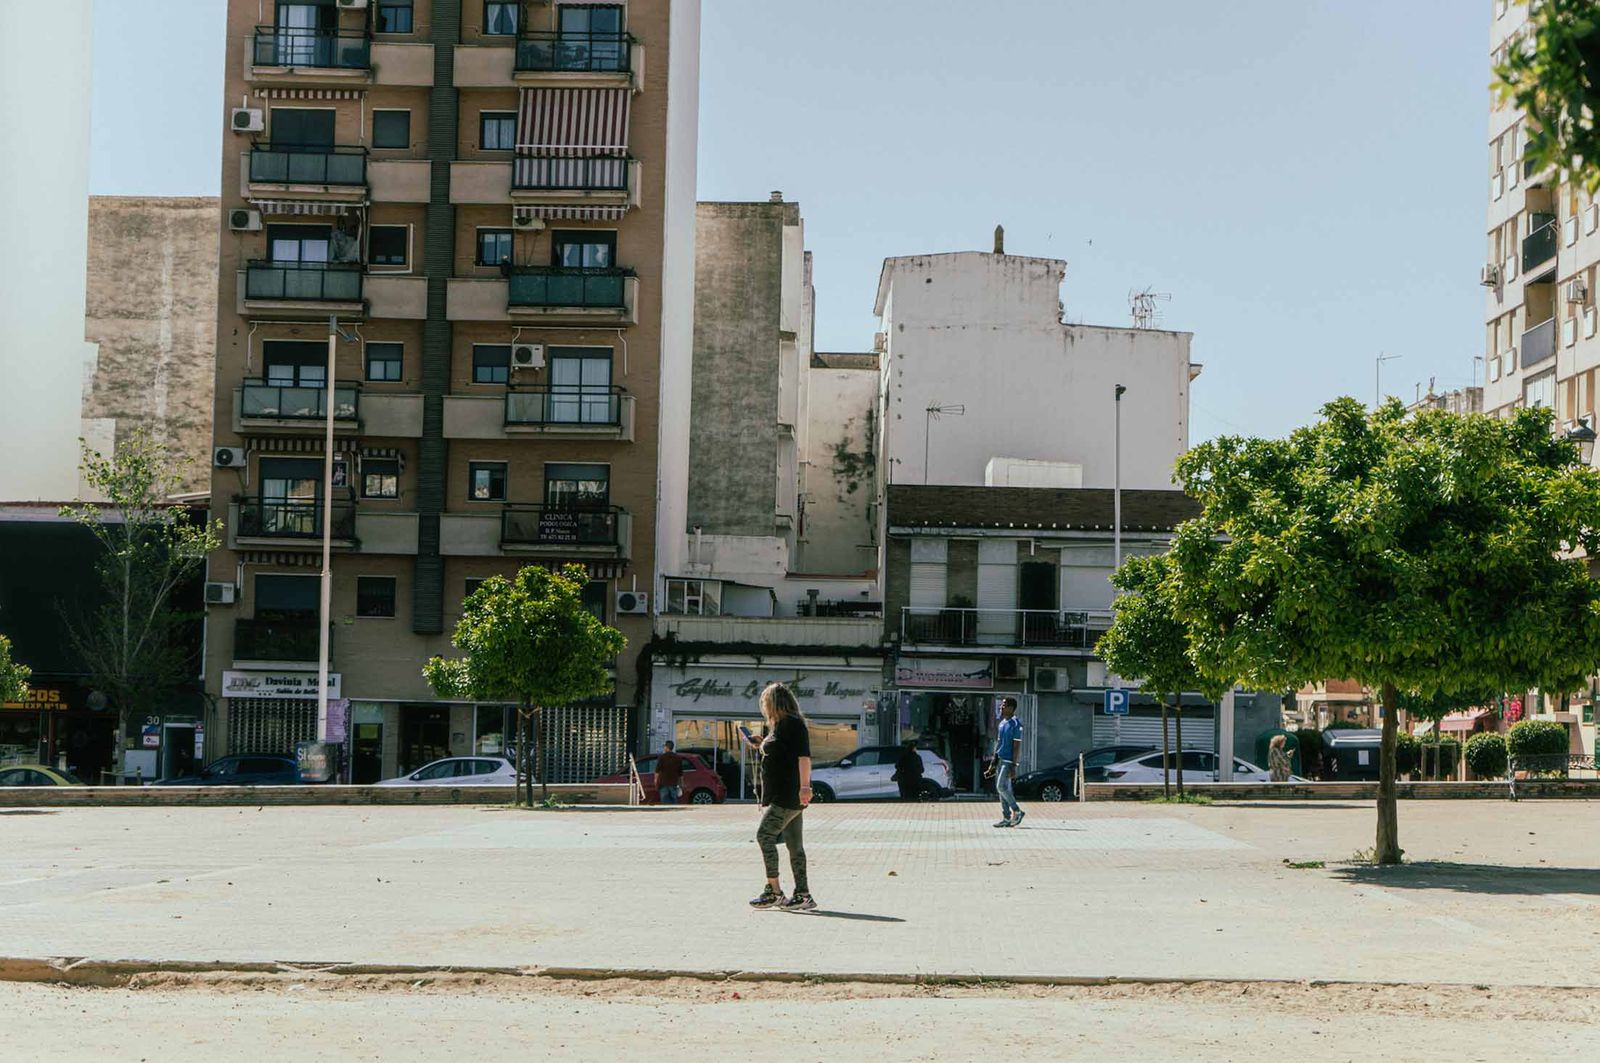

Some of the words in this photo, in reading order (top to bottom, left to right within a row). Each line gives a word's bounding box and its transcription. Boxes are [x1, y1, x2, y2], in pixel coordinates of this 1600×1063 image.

[265, 677, 302, 687] Davinia
[1110, 692, 1124, 712] P
[146, 715, 160, 726] 30
